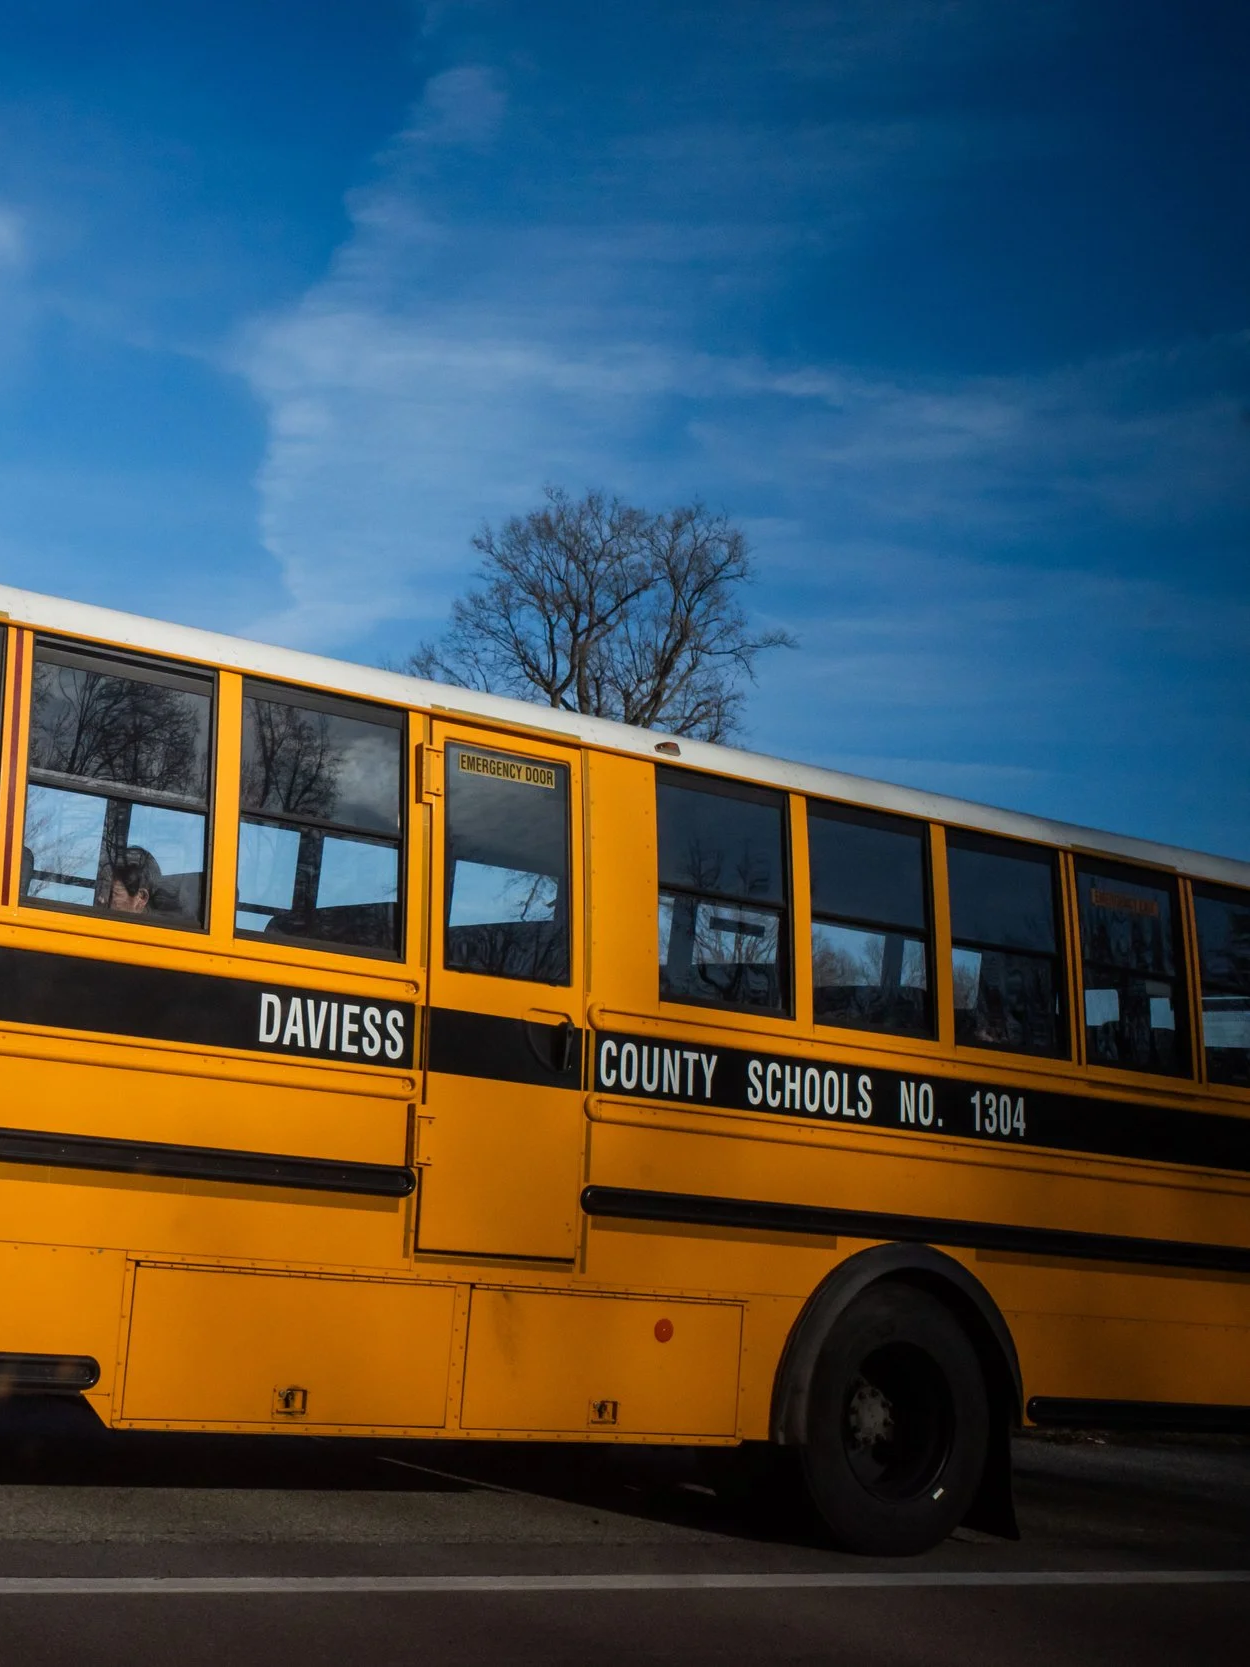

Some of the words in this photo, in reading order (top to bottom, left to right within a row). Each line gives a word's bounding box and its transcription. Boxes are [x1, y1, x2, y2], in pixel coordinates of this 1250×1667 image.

[460, 754, 523, 780] EMERGENCY
[525, 767, 554, 786] DOOR
[258, 992, 405, 1060] DAVIESS
[599, 1039, 718, 1099] COUNTY
[747, 1059, 873, 1119] SCHOOLS
[899, 1080, 944, 1128] NO.
[970, 1090, 1027, 1138] 1304
